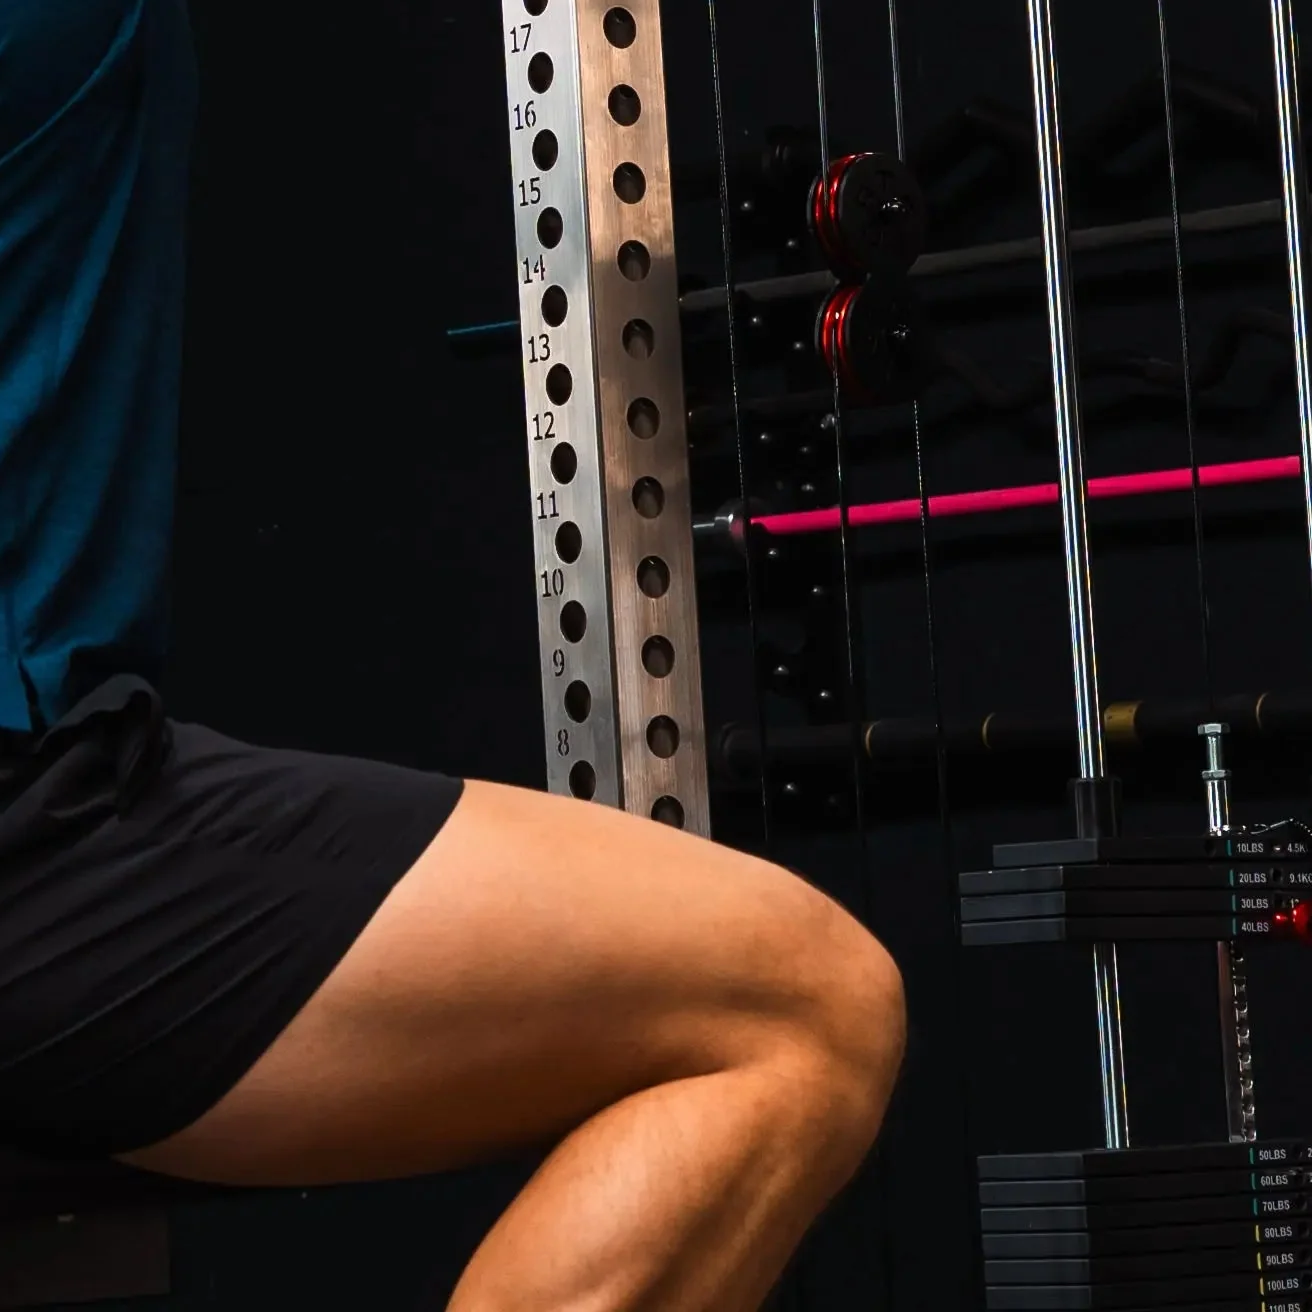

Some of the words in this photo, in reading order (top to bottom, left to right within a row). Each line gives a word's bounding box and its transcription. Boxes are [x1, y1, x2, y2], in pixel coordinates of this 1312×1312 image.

[509, 23, 532, 53] 17
[514, 100, 537, 130] 16
[518, 177, 541, 207] 15
[522, 254, 546, 284] 14
[528, 333, 551, 363] 13
[532, 411, 556, 441] 12
[537, 490, 560, 519] 11
[541, 568, 564, 598] 10
[552, 648, 565, 676] 9
[557, 728, 570, 757] 8
[1236, 842, 1265, 853] 10LBS
[1238, 872, 1268, 884] 20LBS
[1240, 897, 1269, 909] 30LBS
[1240, 921, 1270, 933] 40LBS
[1259, 1149, 1287, 1161] 50LBS
[1260, 1174, 1288, 1187] 60LBS
[1262, 1199, 1290, 1212] 70LBS
[1264, 1226, 1293, 1238] 80LBS
[1266, 1253, 1294, 1266] 90LBS
[1267, 1278, 1299, 1291] 100LBS
[1269, 1303, 1301, 1312] 110LBS
